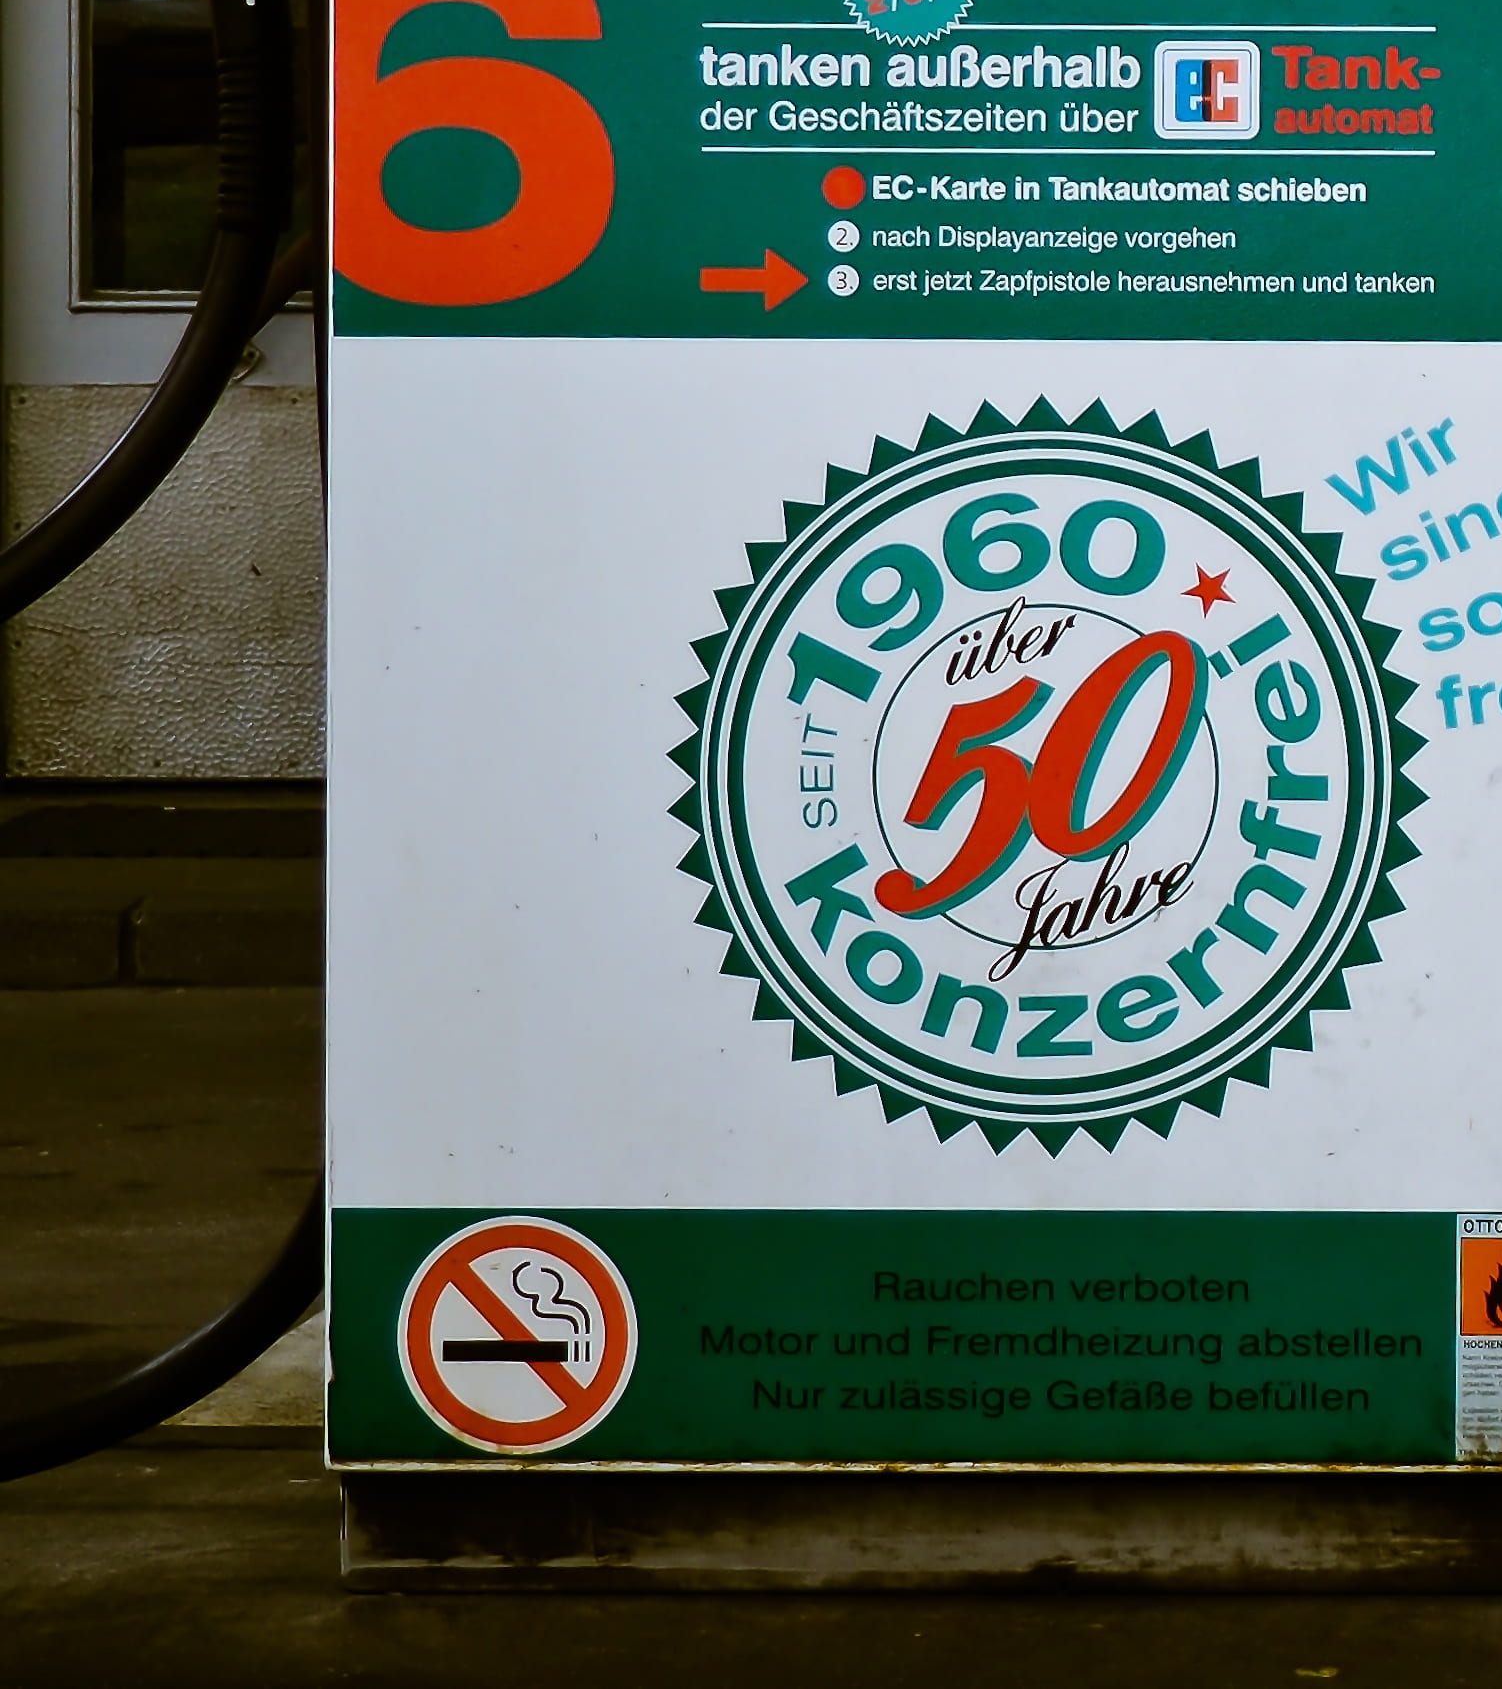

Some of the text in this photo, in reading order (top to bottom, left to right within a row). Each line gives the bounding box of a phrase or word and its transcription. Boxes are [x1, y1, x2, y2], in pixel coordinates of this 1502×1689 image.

[700, 43, 1142, 91] tanken außerhalb
[1271, 45, 1442, 91] Tank-
[701, 100, 1141, 133] der Geschäftszeiten über
[1273, 103, 1434, 145] automat
[873, 175, 1368, 203] EC-Karte in Tankautomat schieben
[873, 227, 932, 248] nach
[940, 226, 1120, 254] Displayanzeige
[1126, 227, 1237, 254] vorgehen
[875, 272, 920, 292] erst
[924, 271, 975, 297] jetzt
[980, 271, 1112, 297] Zapfpistole
[1120, 271, 1296, 294] herausnehmen
[1304, 273, 1349, 294] und
[1356, 273, 1436, 294] tanken
[1325, 417, 1458, 517] Wir
[785, 491, 1167, 709] 1960
[945, 596, 1077, 688] über
[802, 714, 839, 829] SEIT
[874, 630, 1210, 919] 50
[988, 842, 1196, 983] Jahre
[874, 1272, 1250, 1304] Rauchen verboten
[700, 1326, 1423, 1366] Motor und Fremdheizung abstellen
[753, 1380, 1370, 1420] Nur zulässige Gefäße befüllen
